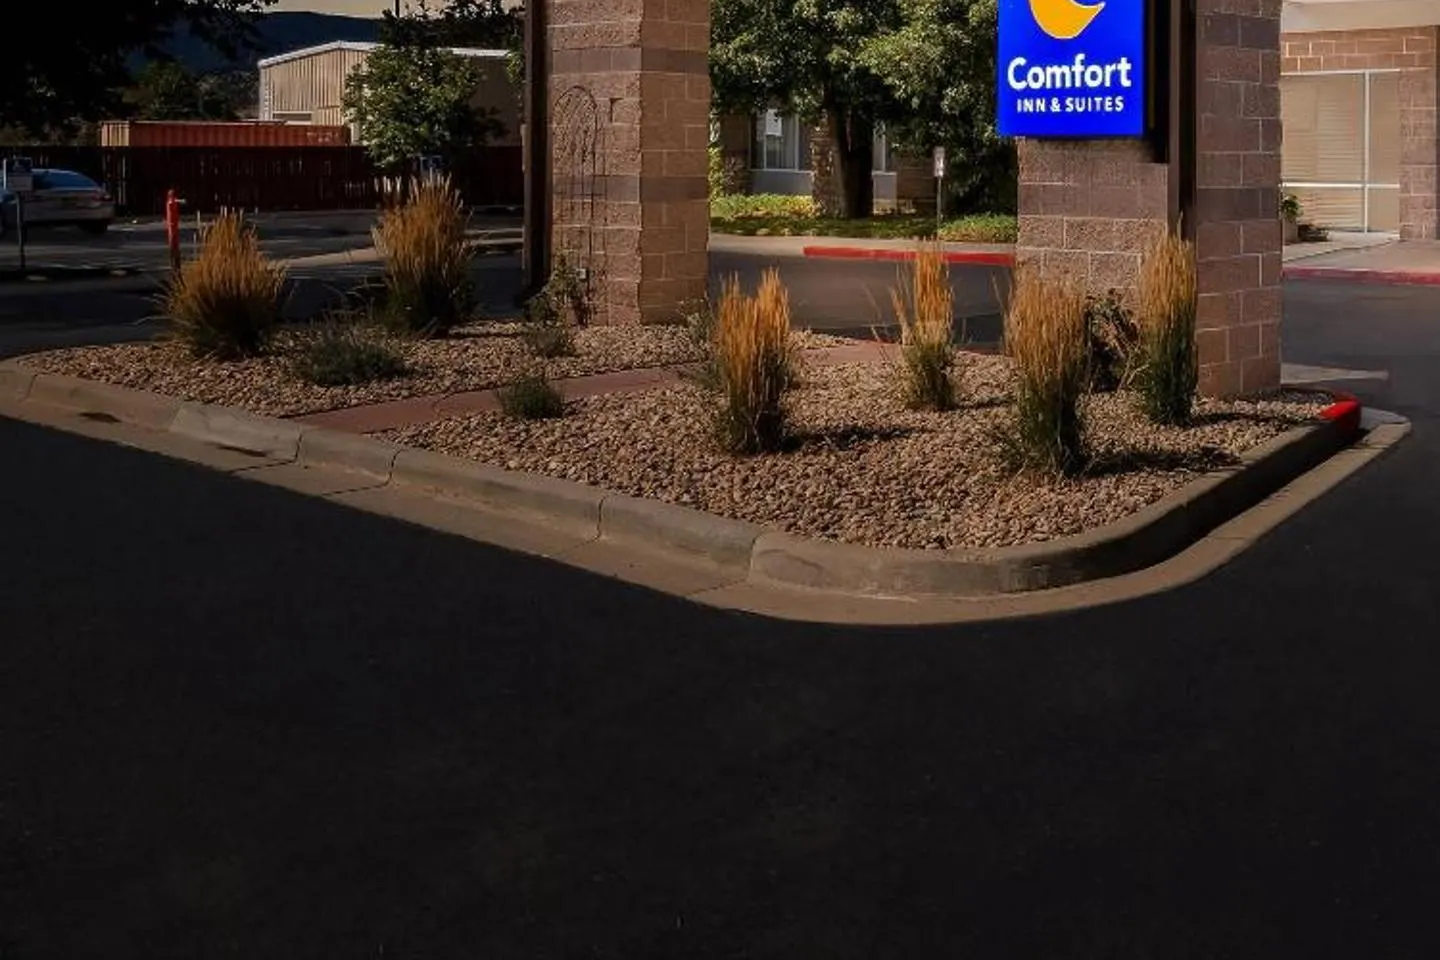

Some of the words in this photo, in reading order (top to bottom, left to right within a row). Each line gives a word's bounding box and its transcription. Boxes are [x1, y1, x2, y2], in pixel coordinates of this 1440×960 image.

[1007, 53, 1132, 90] Comfort
[1017, 97, 1046, 113] INN
[1050, 97, 1062, 113] &
[1065, 96, 1125, 113] SUITES
